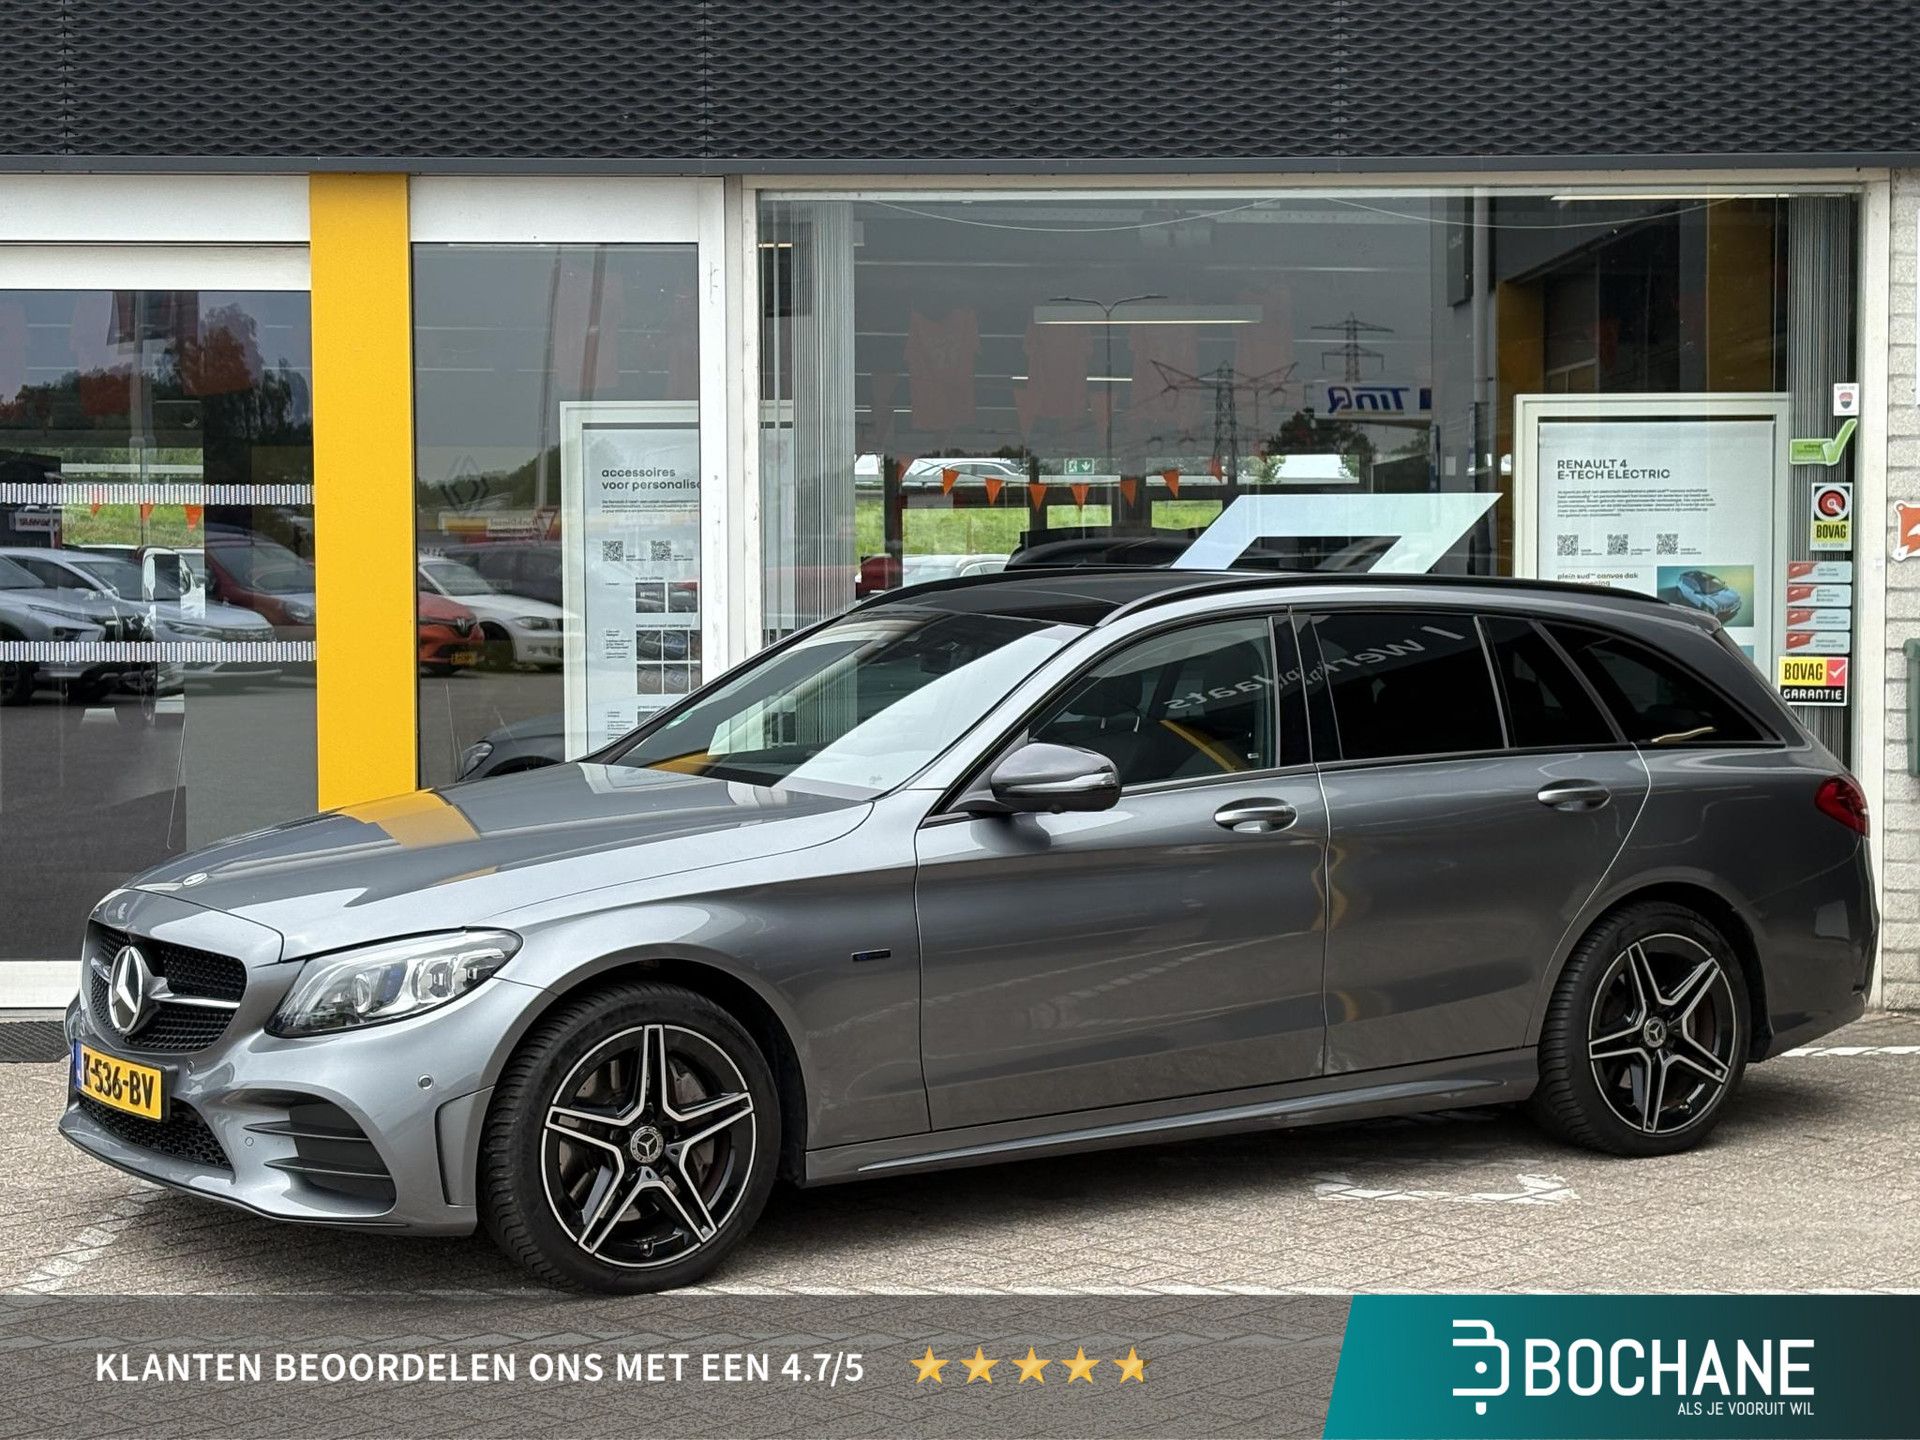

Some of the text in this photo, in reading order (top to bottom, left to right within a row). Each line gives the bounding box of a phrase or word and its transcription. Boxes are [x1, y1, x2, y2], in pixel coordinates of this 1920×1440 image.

[1557, 459, 1628, 469] RENAULT 4
[601, 467, 676, 478] accessoires
[1557, 469, 1671, 480] E-TECH ELECTRIC
[602, 482, 630, 490] voor
[1816, 524, 1847, 539] BOVAG
[1784, 663, 1823, 681] BOVAG
[1783, 688, 1842, 701] GARANTIE
